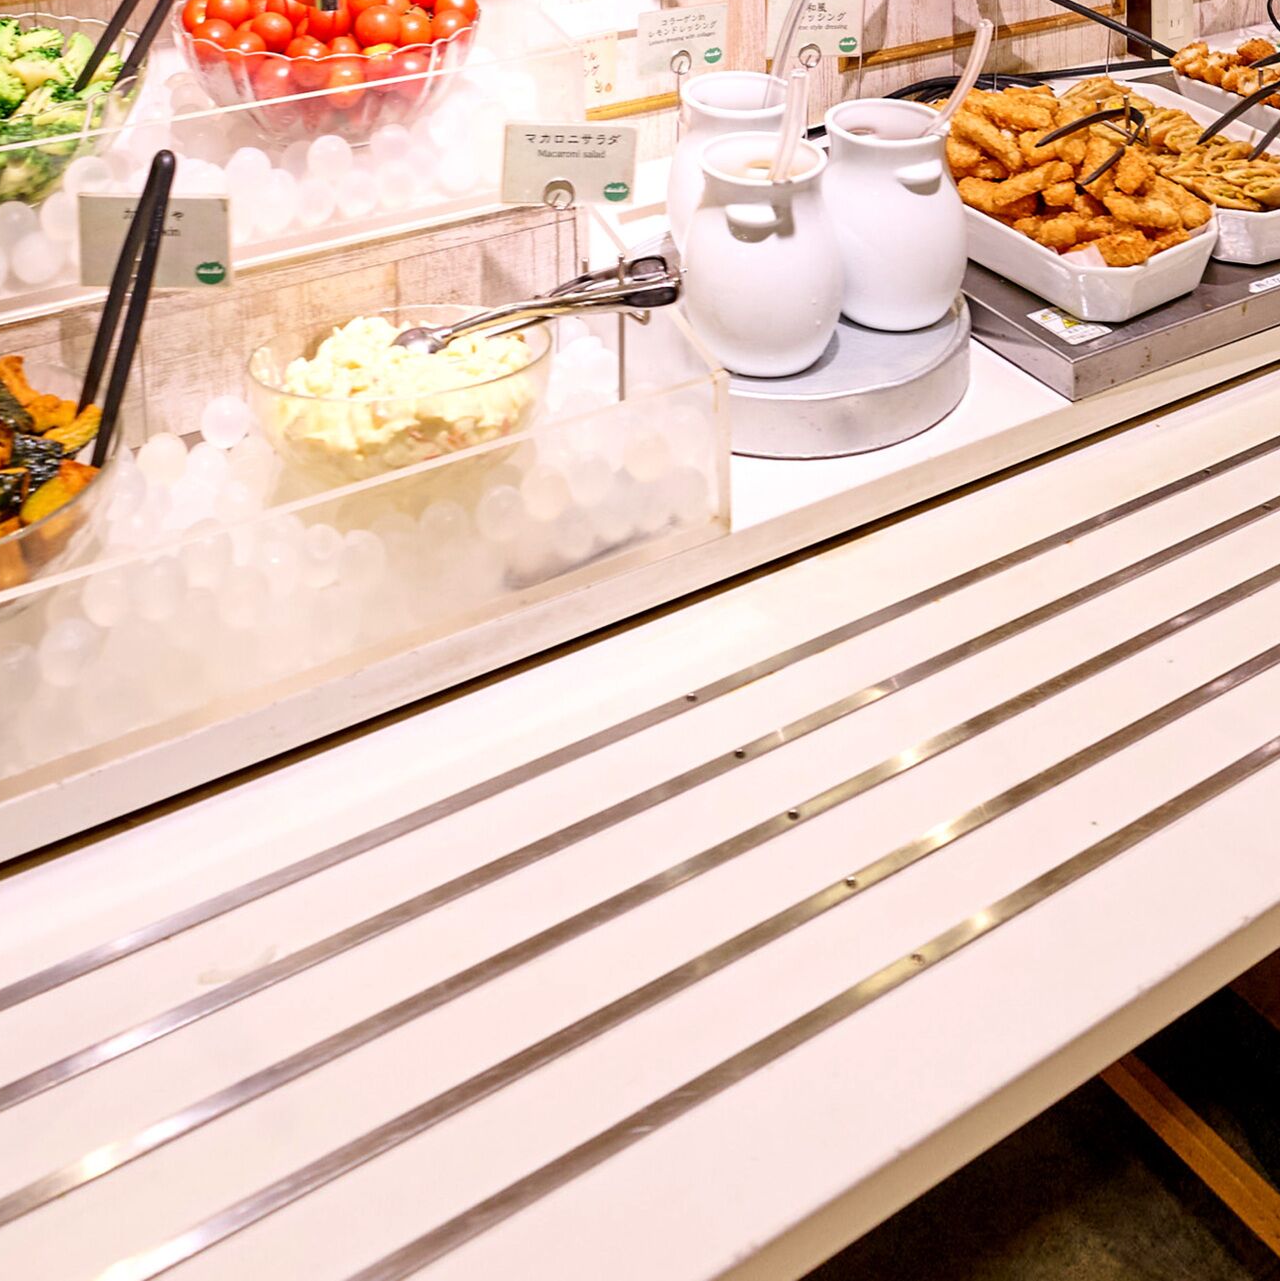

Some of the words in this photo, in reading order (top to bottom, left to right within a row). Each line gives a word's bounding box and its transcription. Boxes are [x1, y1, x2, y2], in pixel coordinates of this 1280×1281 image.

[525, 134, 622, 146] マカロニサラダ
